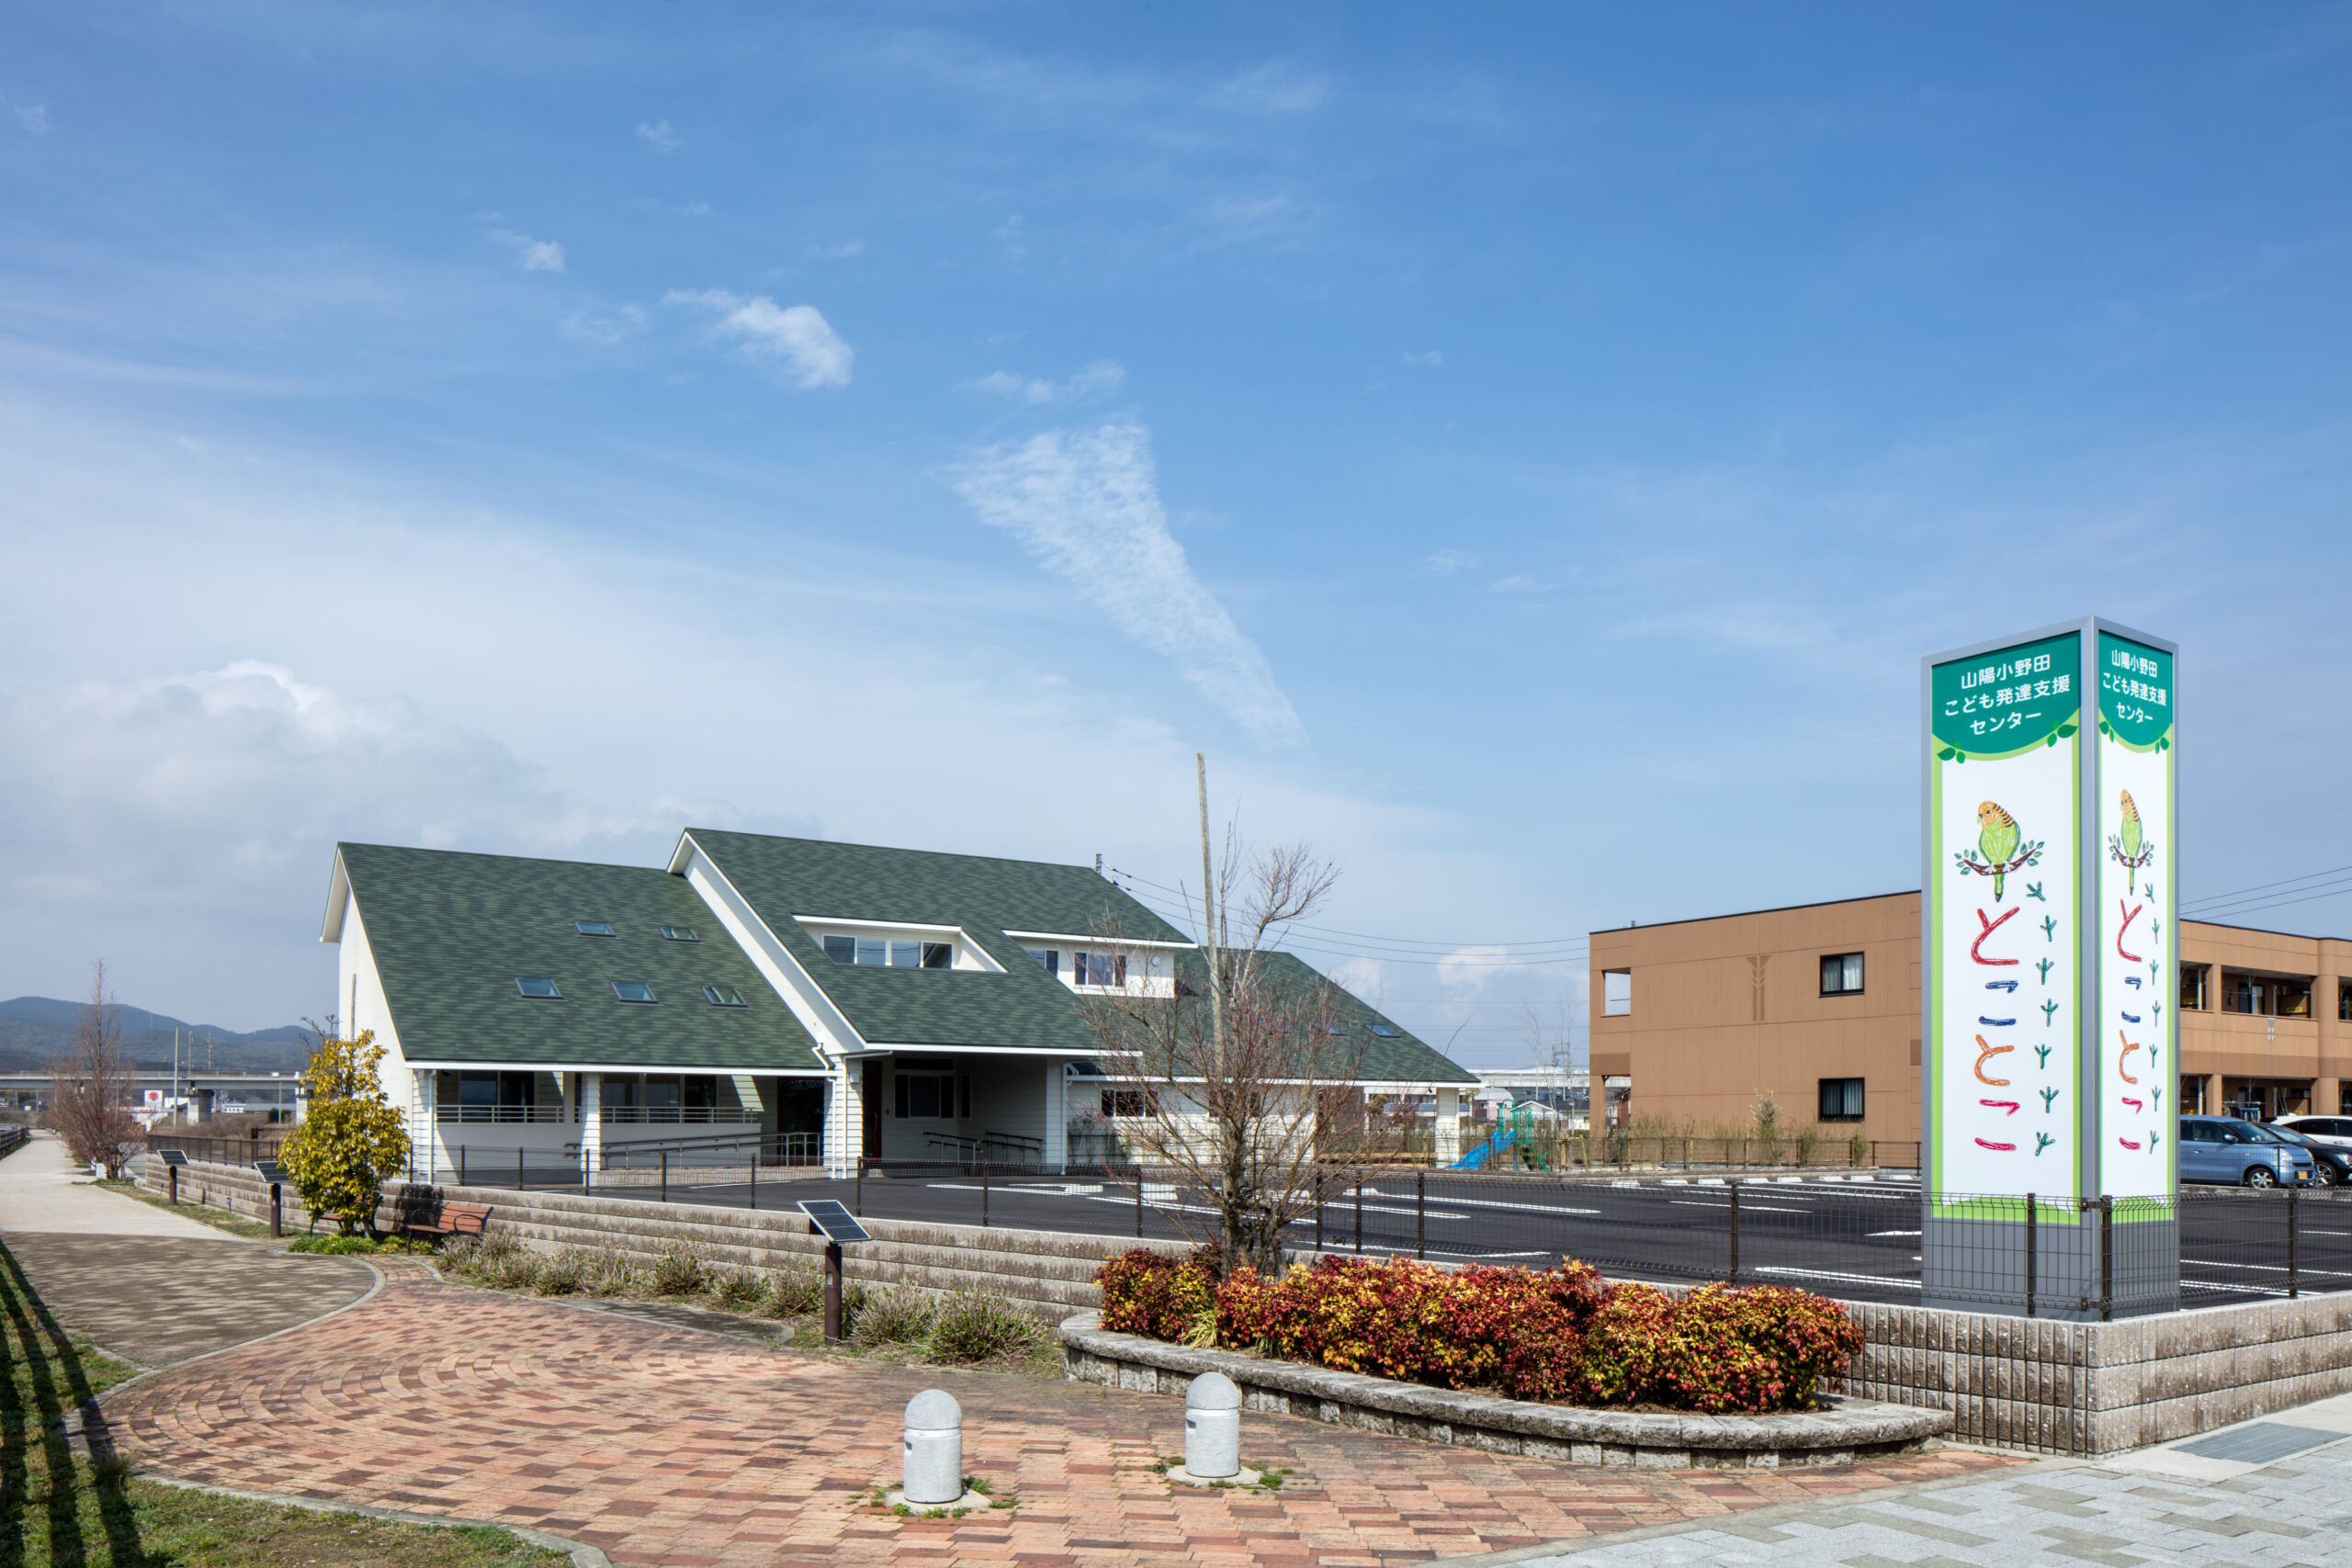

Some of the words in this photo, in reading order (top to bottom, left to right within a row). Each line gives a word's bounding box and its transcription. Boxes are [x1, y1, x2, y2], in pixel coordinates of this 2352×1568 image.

[1961, 654, 2051, 689] 山陽小野田
[2111, 649, 2158, 678] 山陽小野田
[1944, 674, 2070, 716] こども発達支援
[2103, 671, 2167, 706] こども発達支援
[1969, 711, 2041, 736] センター
[2116, 702, 2154, 724] センター
[1970, 907, 2020, 1152] とことこ
[2117, 899, 2143, 1150] とことこ
